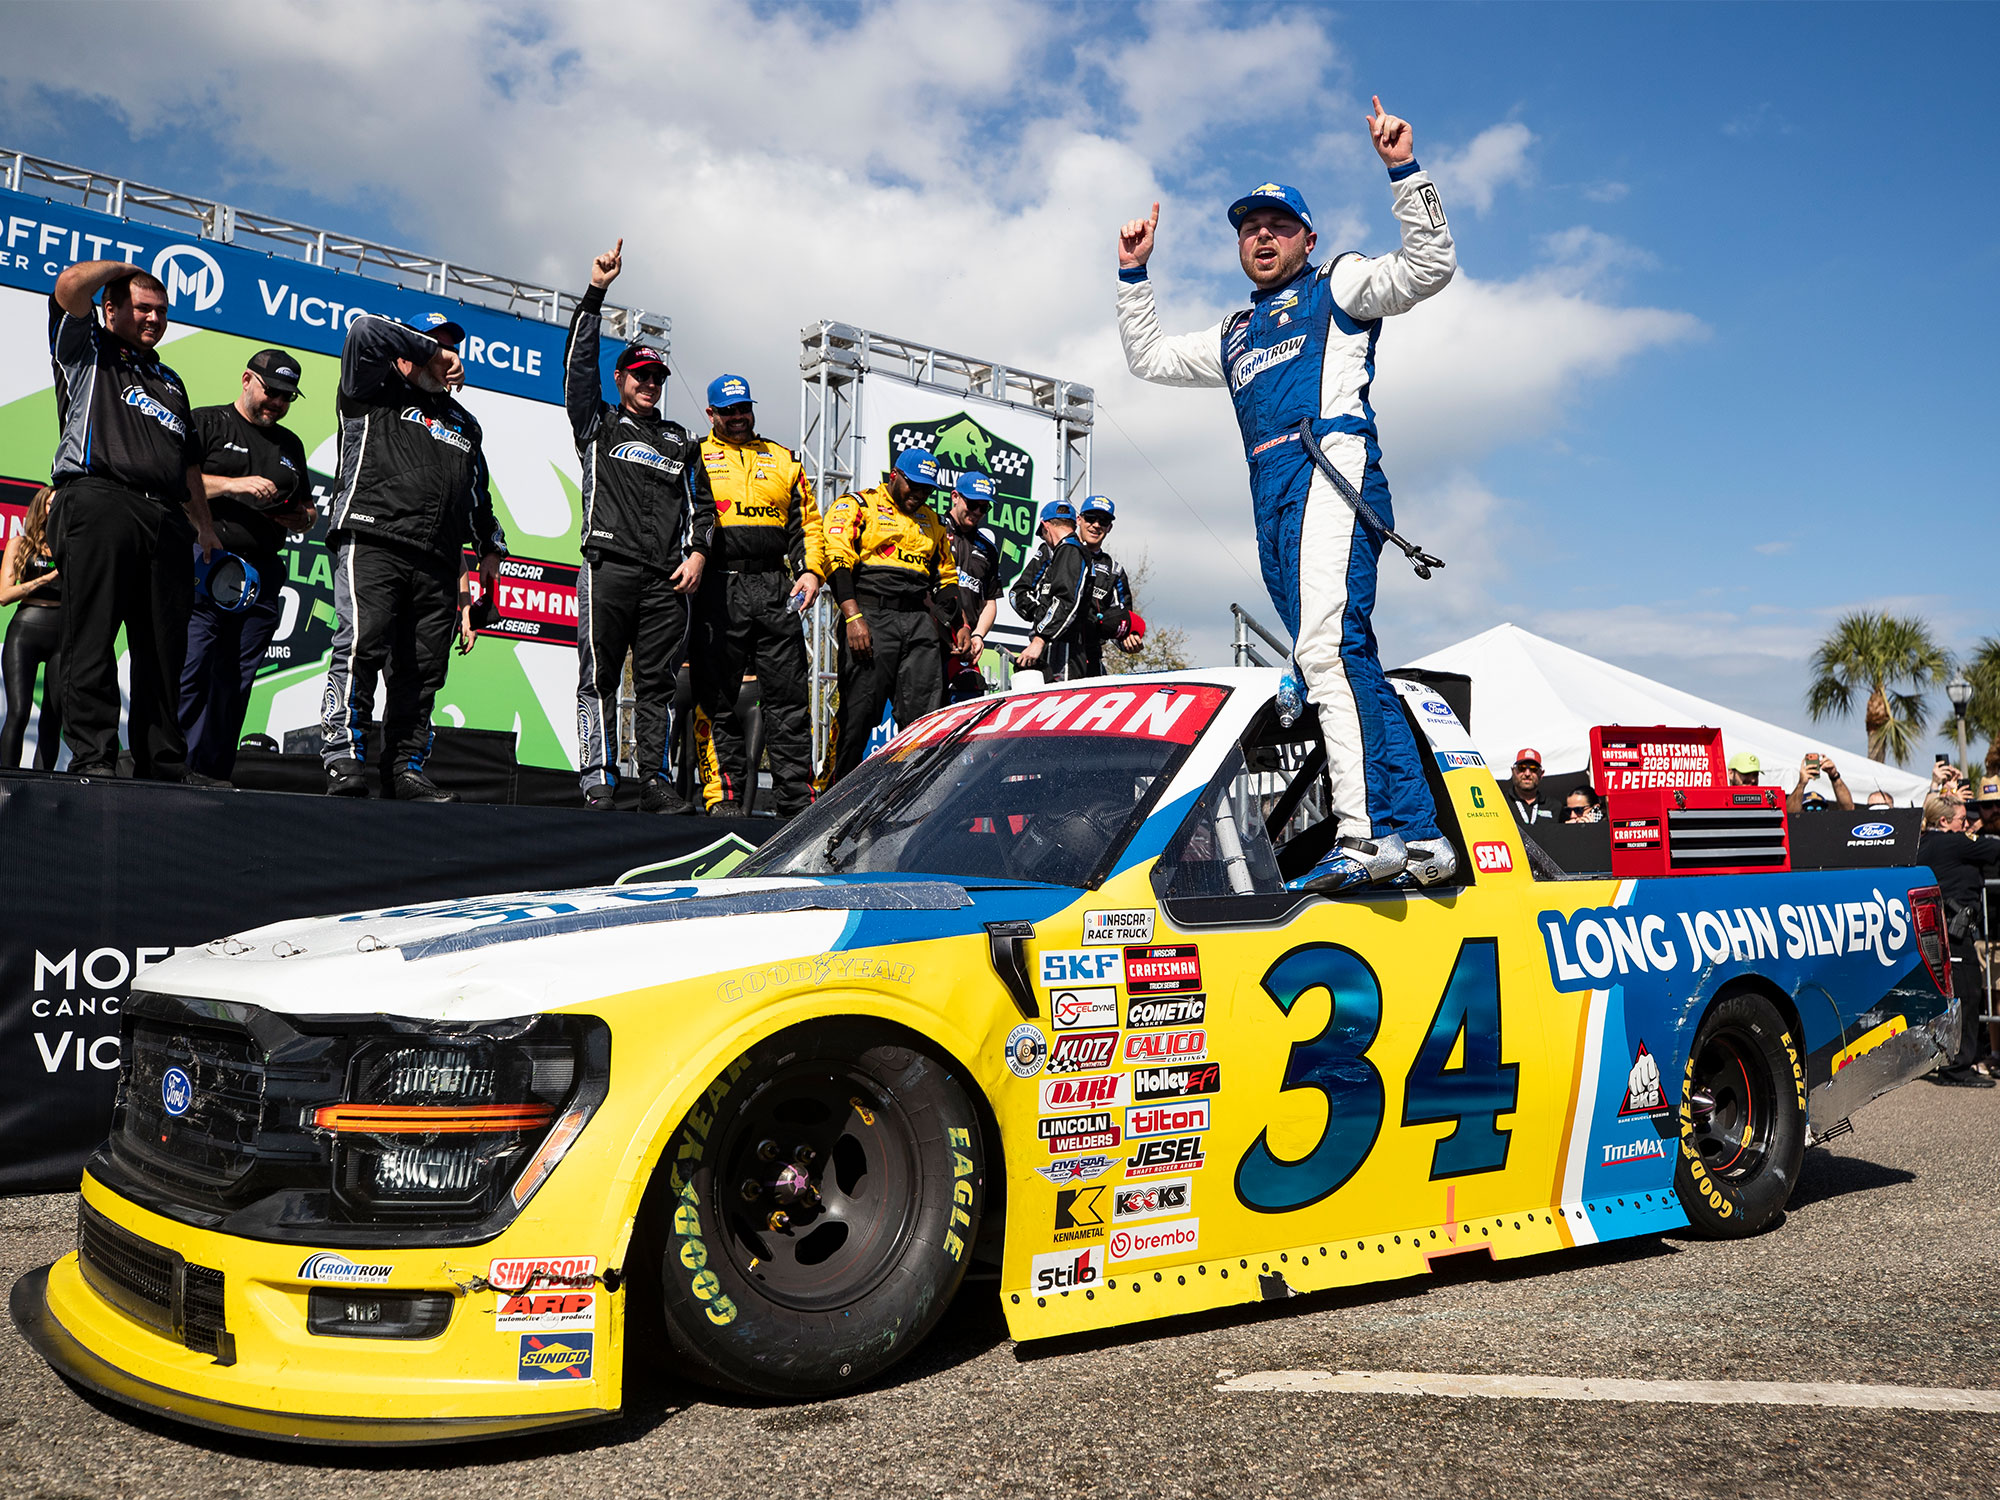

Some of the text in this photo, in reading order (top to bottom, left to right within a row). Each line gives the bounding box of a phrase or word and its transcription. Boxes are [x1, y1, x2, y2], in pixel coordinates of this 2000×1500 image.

[0, 216, 144, 266] FFITT
[458, 335, 542, 377] IRCLE
[629, 448, 684, 470] FRONTROW
[505, 619, 541, 635] SERIES
[1428, 701, 1450, 716] Ford
[1427, 717, 1462, 727] RACING
[1447, 754, 1473, 767] Mobil
[1643, 758, 1709, 771] 2026 WINNER
[1621, 772, 1712, 789] PETERSBURG
[1735, 795, 1761, 803] CRAFTSMAN
[1614, 829, 1659, 840] CRAFTSMAN
[1859, 825, 1887, 836] Ford
[1847, 838, 1895, 847] RACING
[1475, 844, 1512, 869] SEM
[1106, 913, 1146, 927] NASCAR
[1088, 928, 1148, 940] RACE TRUCK
[1546, 887, 1908, 981] LONG JOHN SILVER'S
[1153, 948, 1177, 957] NASCAR
[716, 951, 916, 1003] GOODYEAR
[1043, 953, 1119, 981] SKF
[1129, 961, 1196, 977] CRAFTSMAN
[1129, 998, 1204, 1024] COMETIC
[1008, 1026, 1043, 1044] CHAMPION
[1125, 1031, 1206, 1059] CALICO
[1059, 1037, 1114, 1063] KLOTZ
[1166, 1054, 1206, 1063] COATINGS
[1009, 1056, 1044, 1076] IRRIGATION
[1079, 1060, 1108, 1069] SYNTHETICS
[1233, 936, 1520, 1214] 34
[1780, 1031, 1807, 1113] EAGLE
[1050, 1073, 1125, 1104] DART
[1136, 1065, 1218, 1095] Holley EFI
[166, 1074, 186, 1109] Ford
[1629, 1089, 1660, 1110] BKB
[1041, 1115, 1108, 1136] LINCOLN
[1131, 1109, 1204, 1134] tilton
[1056, 1133, 1114, 1152] WELDERS
[1127, 1137, 1204, 1168] JESEL
[1051, 1156, 1106, 1173] FIVE STAR
[1132, 1161, 1197, 1176] SHAFT ROCKER ARMS
[943, 1127, 975, 1263] EAGLE
[1115, 1182, 1188, 1217] KOOKS
[1053, 1226, 1105, 1243] KENNAMETAL
[1134, 1229, 1196, 1251] brembo
[318, 1263, 394, 1276] FRONTROW
[492, 1258, 593, 1288] SIMPSON
[1037, 1248, 1097, 1291] Stilo
[499, 1293, 594, 1315] ARP
[523, 1350, 588, 1365] SUNOCO
